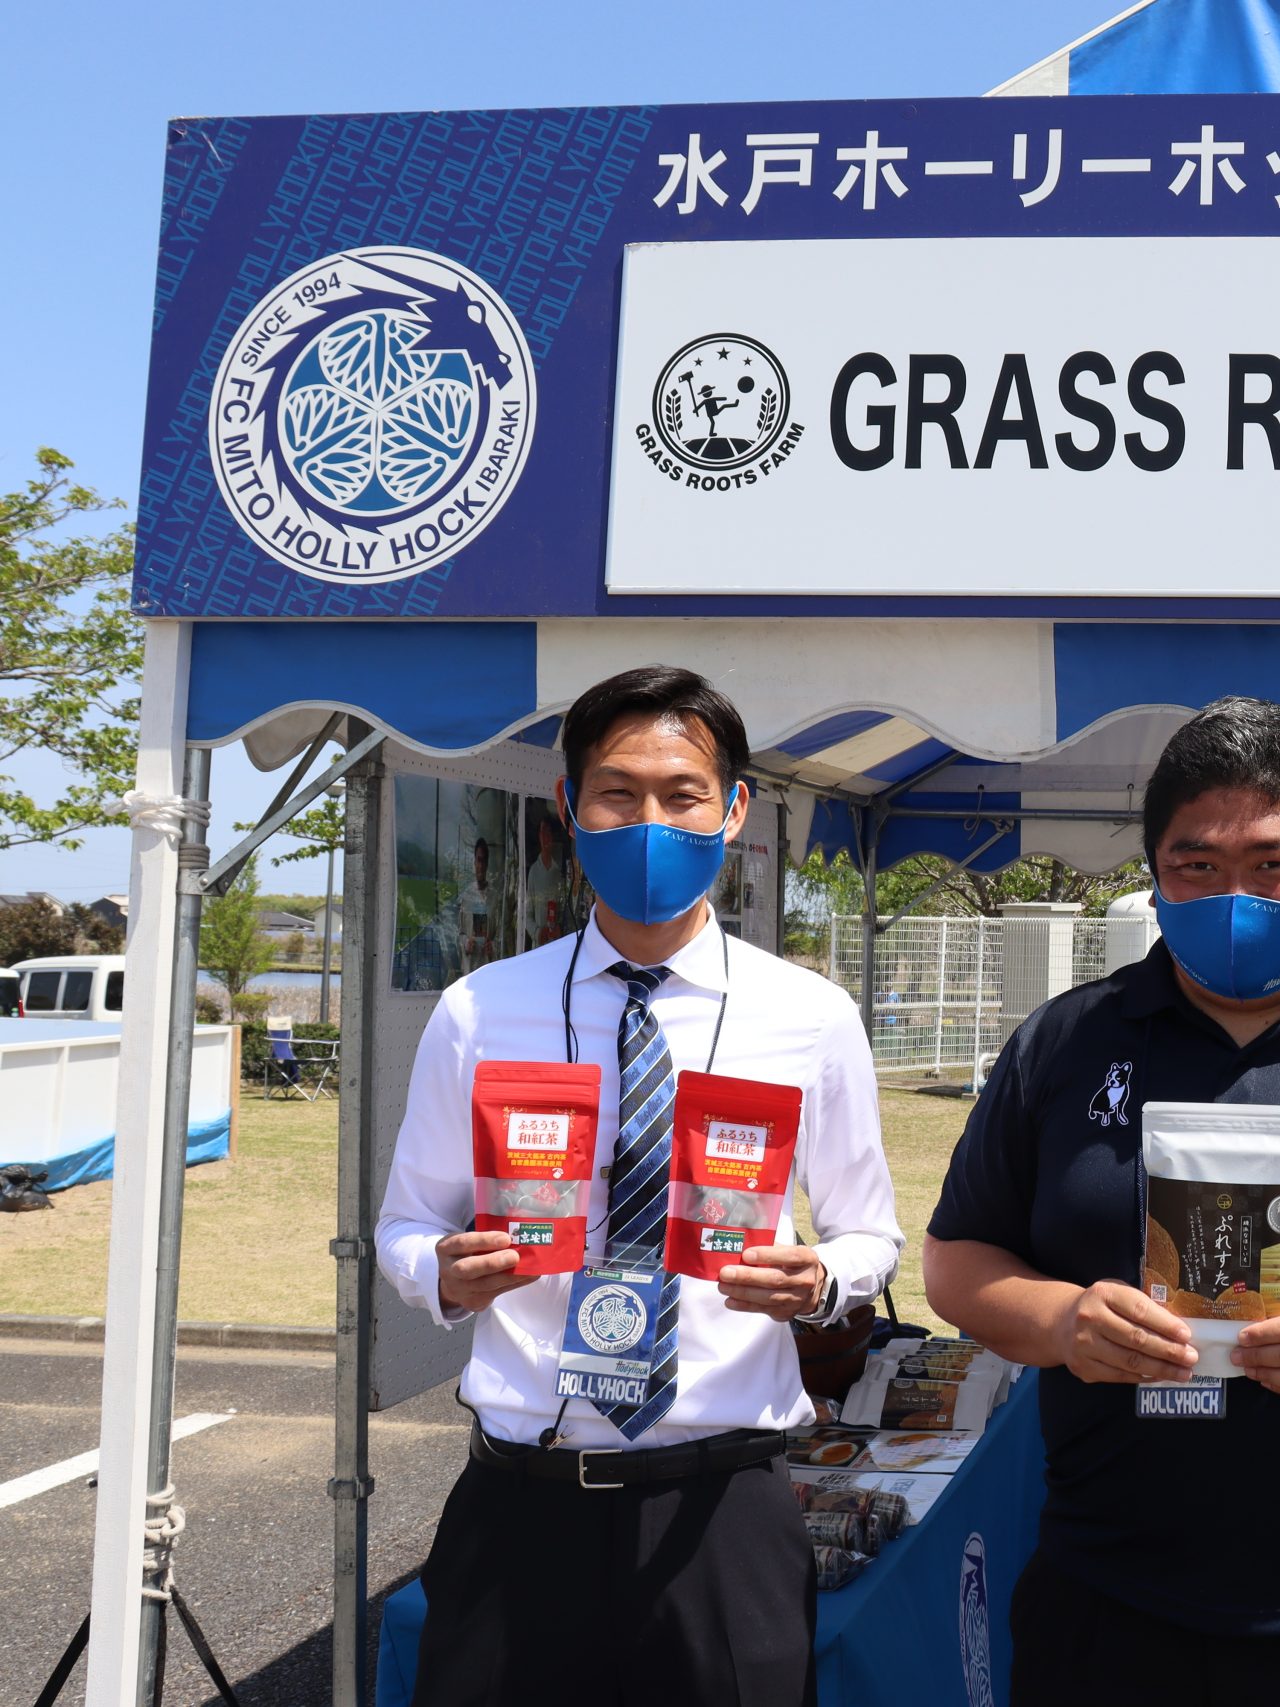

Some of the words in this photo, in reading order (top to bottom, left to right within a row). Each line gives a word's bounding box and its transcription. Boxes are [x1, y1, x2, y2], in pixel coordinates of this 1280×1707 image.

[241, 305, 292, 367] SINCE
[293, 271, 341, 307] 1994
[223, 377, 256, 424] FC
[830, 351, 1186, 473] GRASS
[475, 400, 521, 492] IBARAKI
[635, 423, 684, 482] GRASS
[685, 468, 758, 492] ROOTS
[758, 422, 806, 477] FARM
[222, 433, 276, 521] MITO
[271, 515, 379, 571] HOLLY
[389, 486, 487, 566] HOCK
[518, 1119, 560, 1130] ふるうち
[518, 1131, 558, 1146] 和紅茶
[716, 1128, 758, 1142] ふるうち
[716, 1140, 756, 1156] 和紅茶
[557, 1371, 648, 1405] HOLLYHOCK
[1141, 1390, 1219, 1415] HOLLYHOCK
